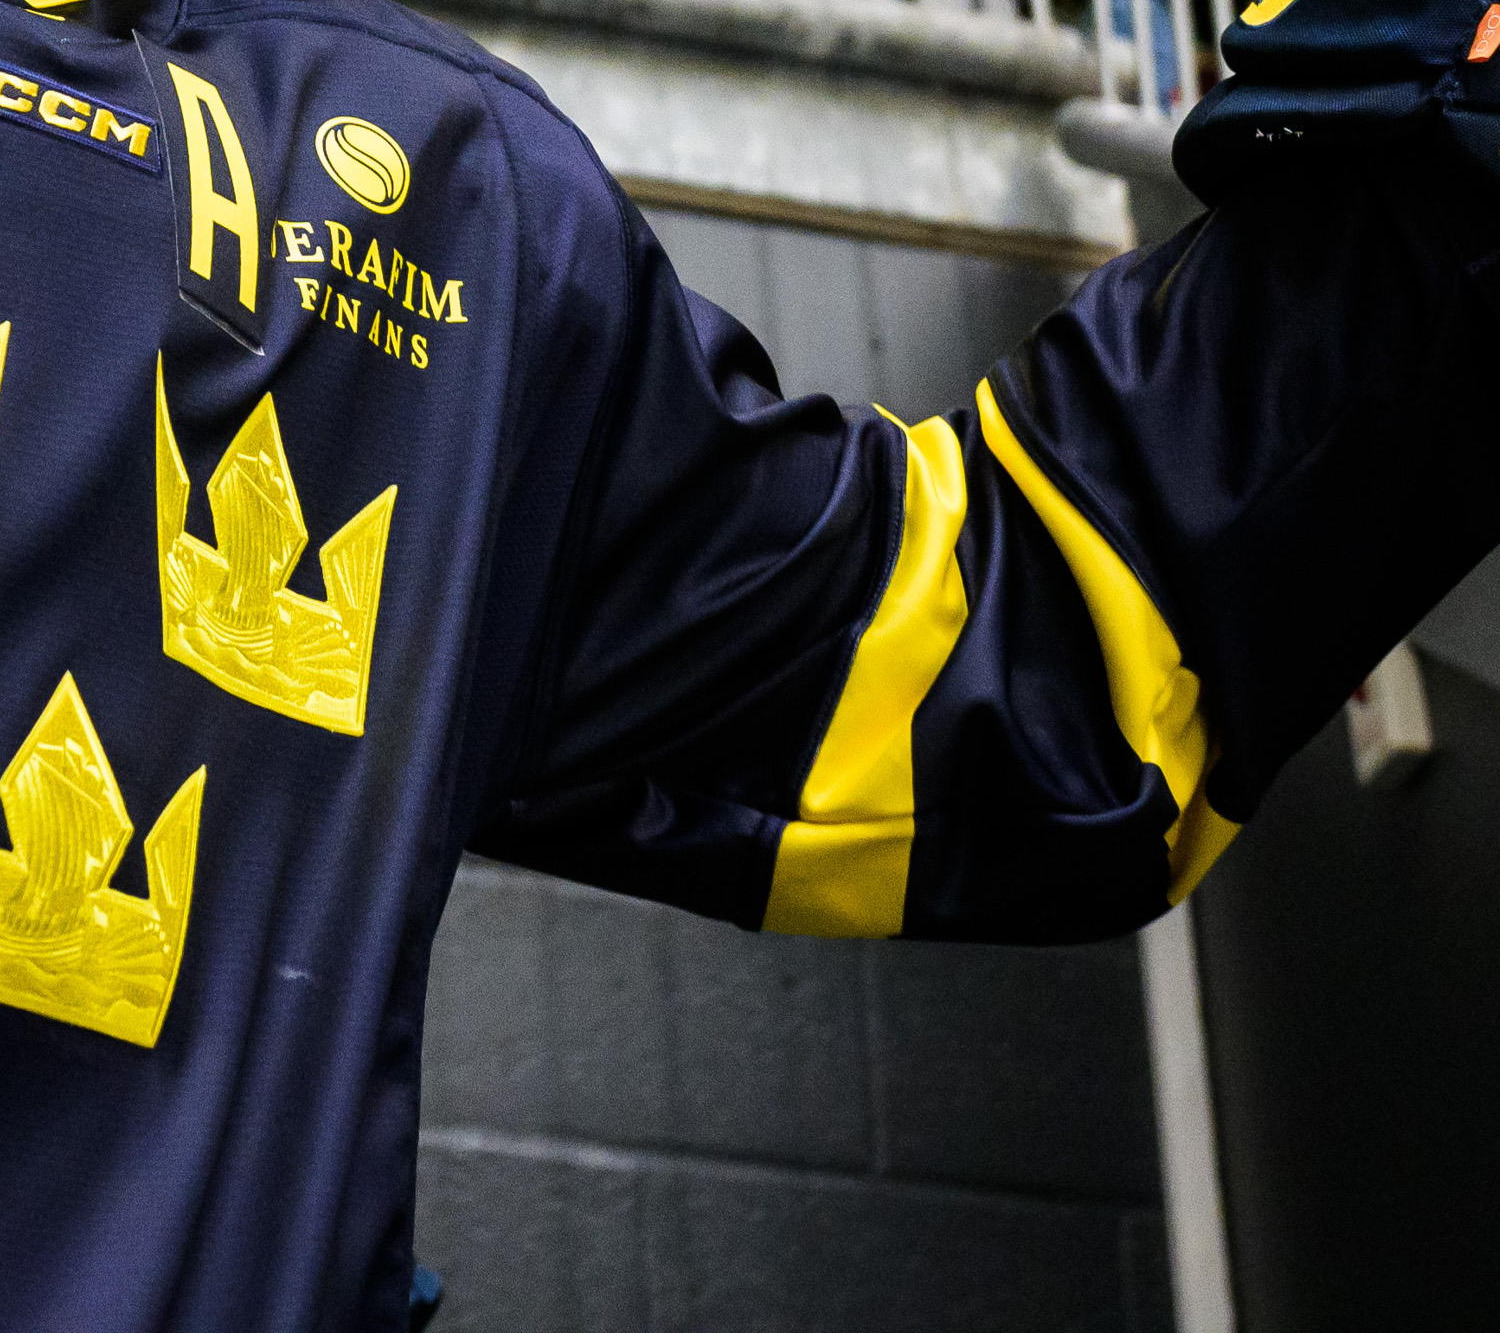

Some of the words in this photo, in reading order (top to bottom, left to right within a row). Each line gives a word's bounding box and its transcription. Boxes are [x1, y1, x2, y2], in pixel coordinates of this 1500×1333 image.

[166, 62, 260, 315] A
[270, 215, 470, 324] ERAFIM
[293, 277, 430, 370] FINANS
